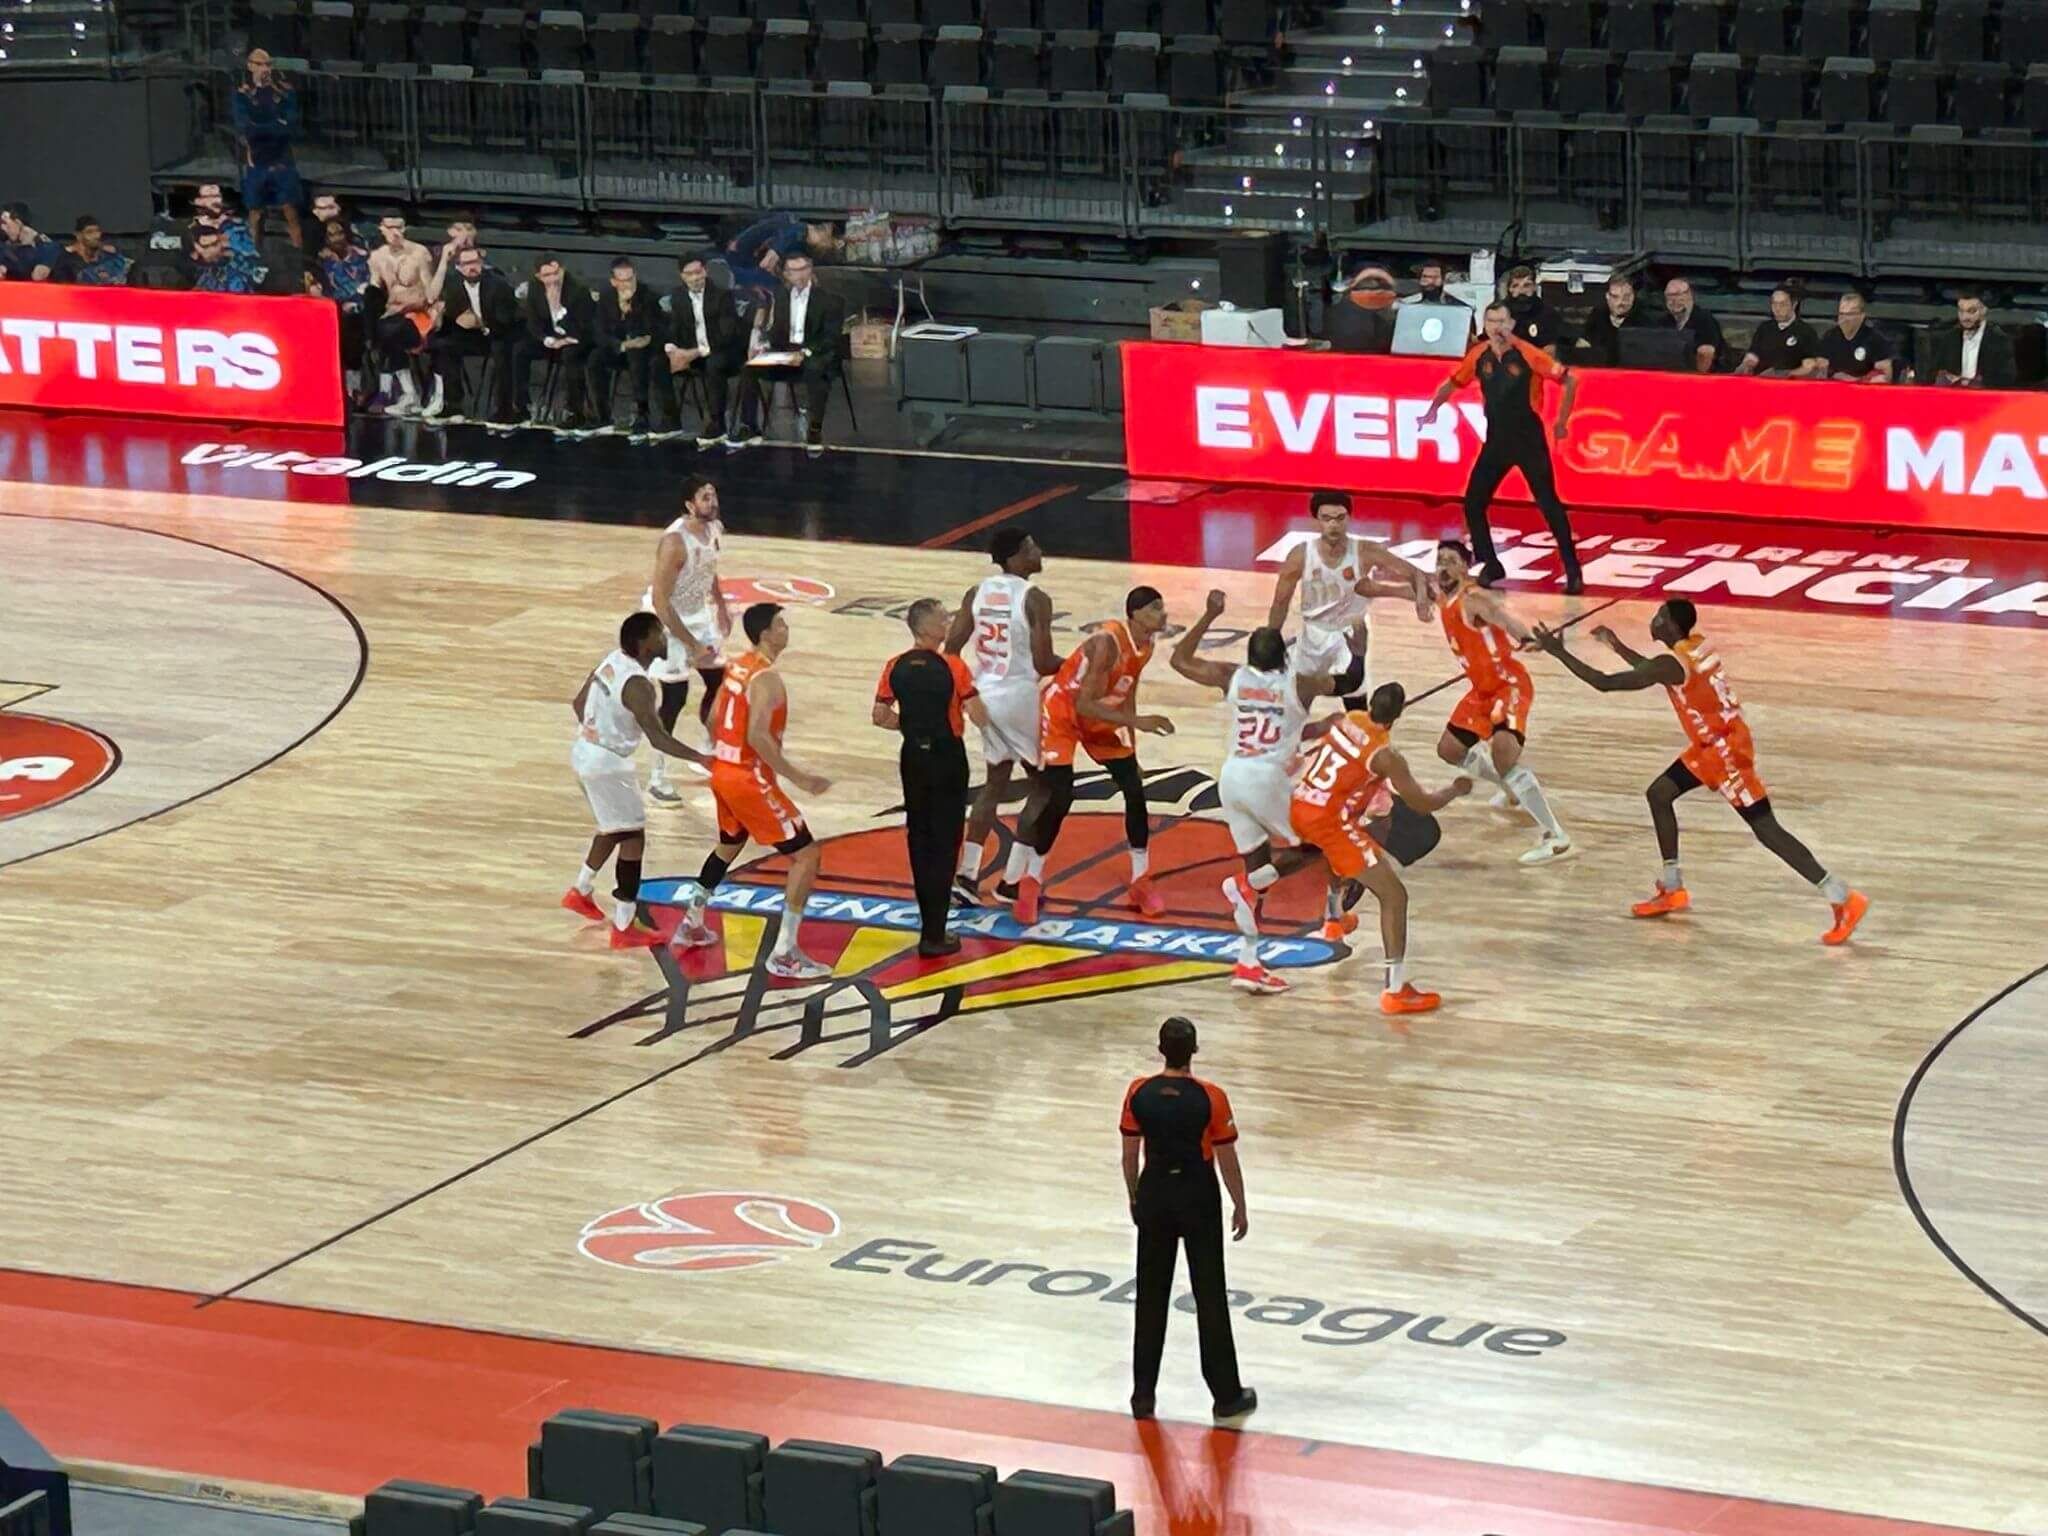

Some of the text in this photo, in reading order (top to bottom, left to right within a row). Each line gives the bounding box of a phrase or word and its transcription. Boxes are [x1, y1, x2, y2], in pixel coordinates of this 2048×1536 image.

[0, 319, 281, 391] TTERS
[1562, 409, 1860, 490] GAME
[1886, 426, 2048, 500] MA
[1685, 543, 1970, 573] ARENA
[1308, 743, 1348, 790] 13
